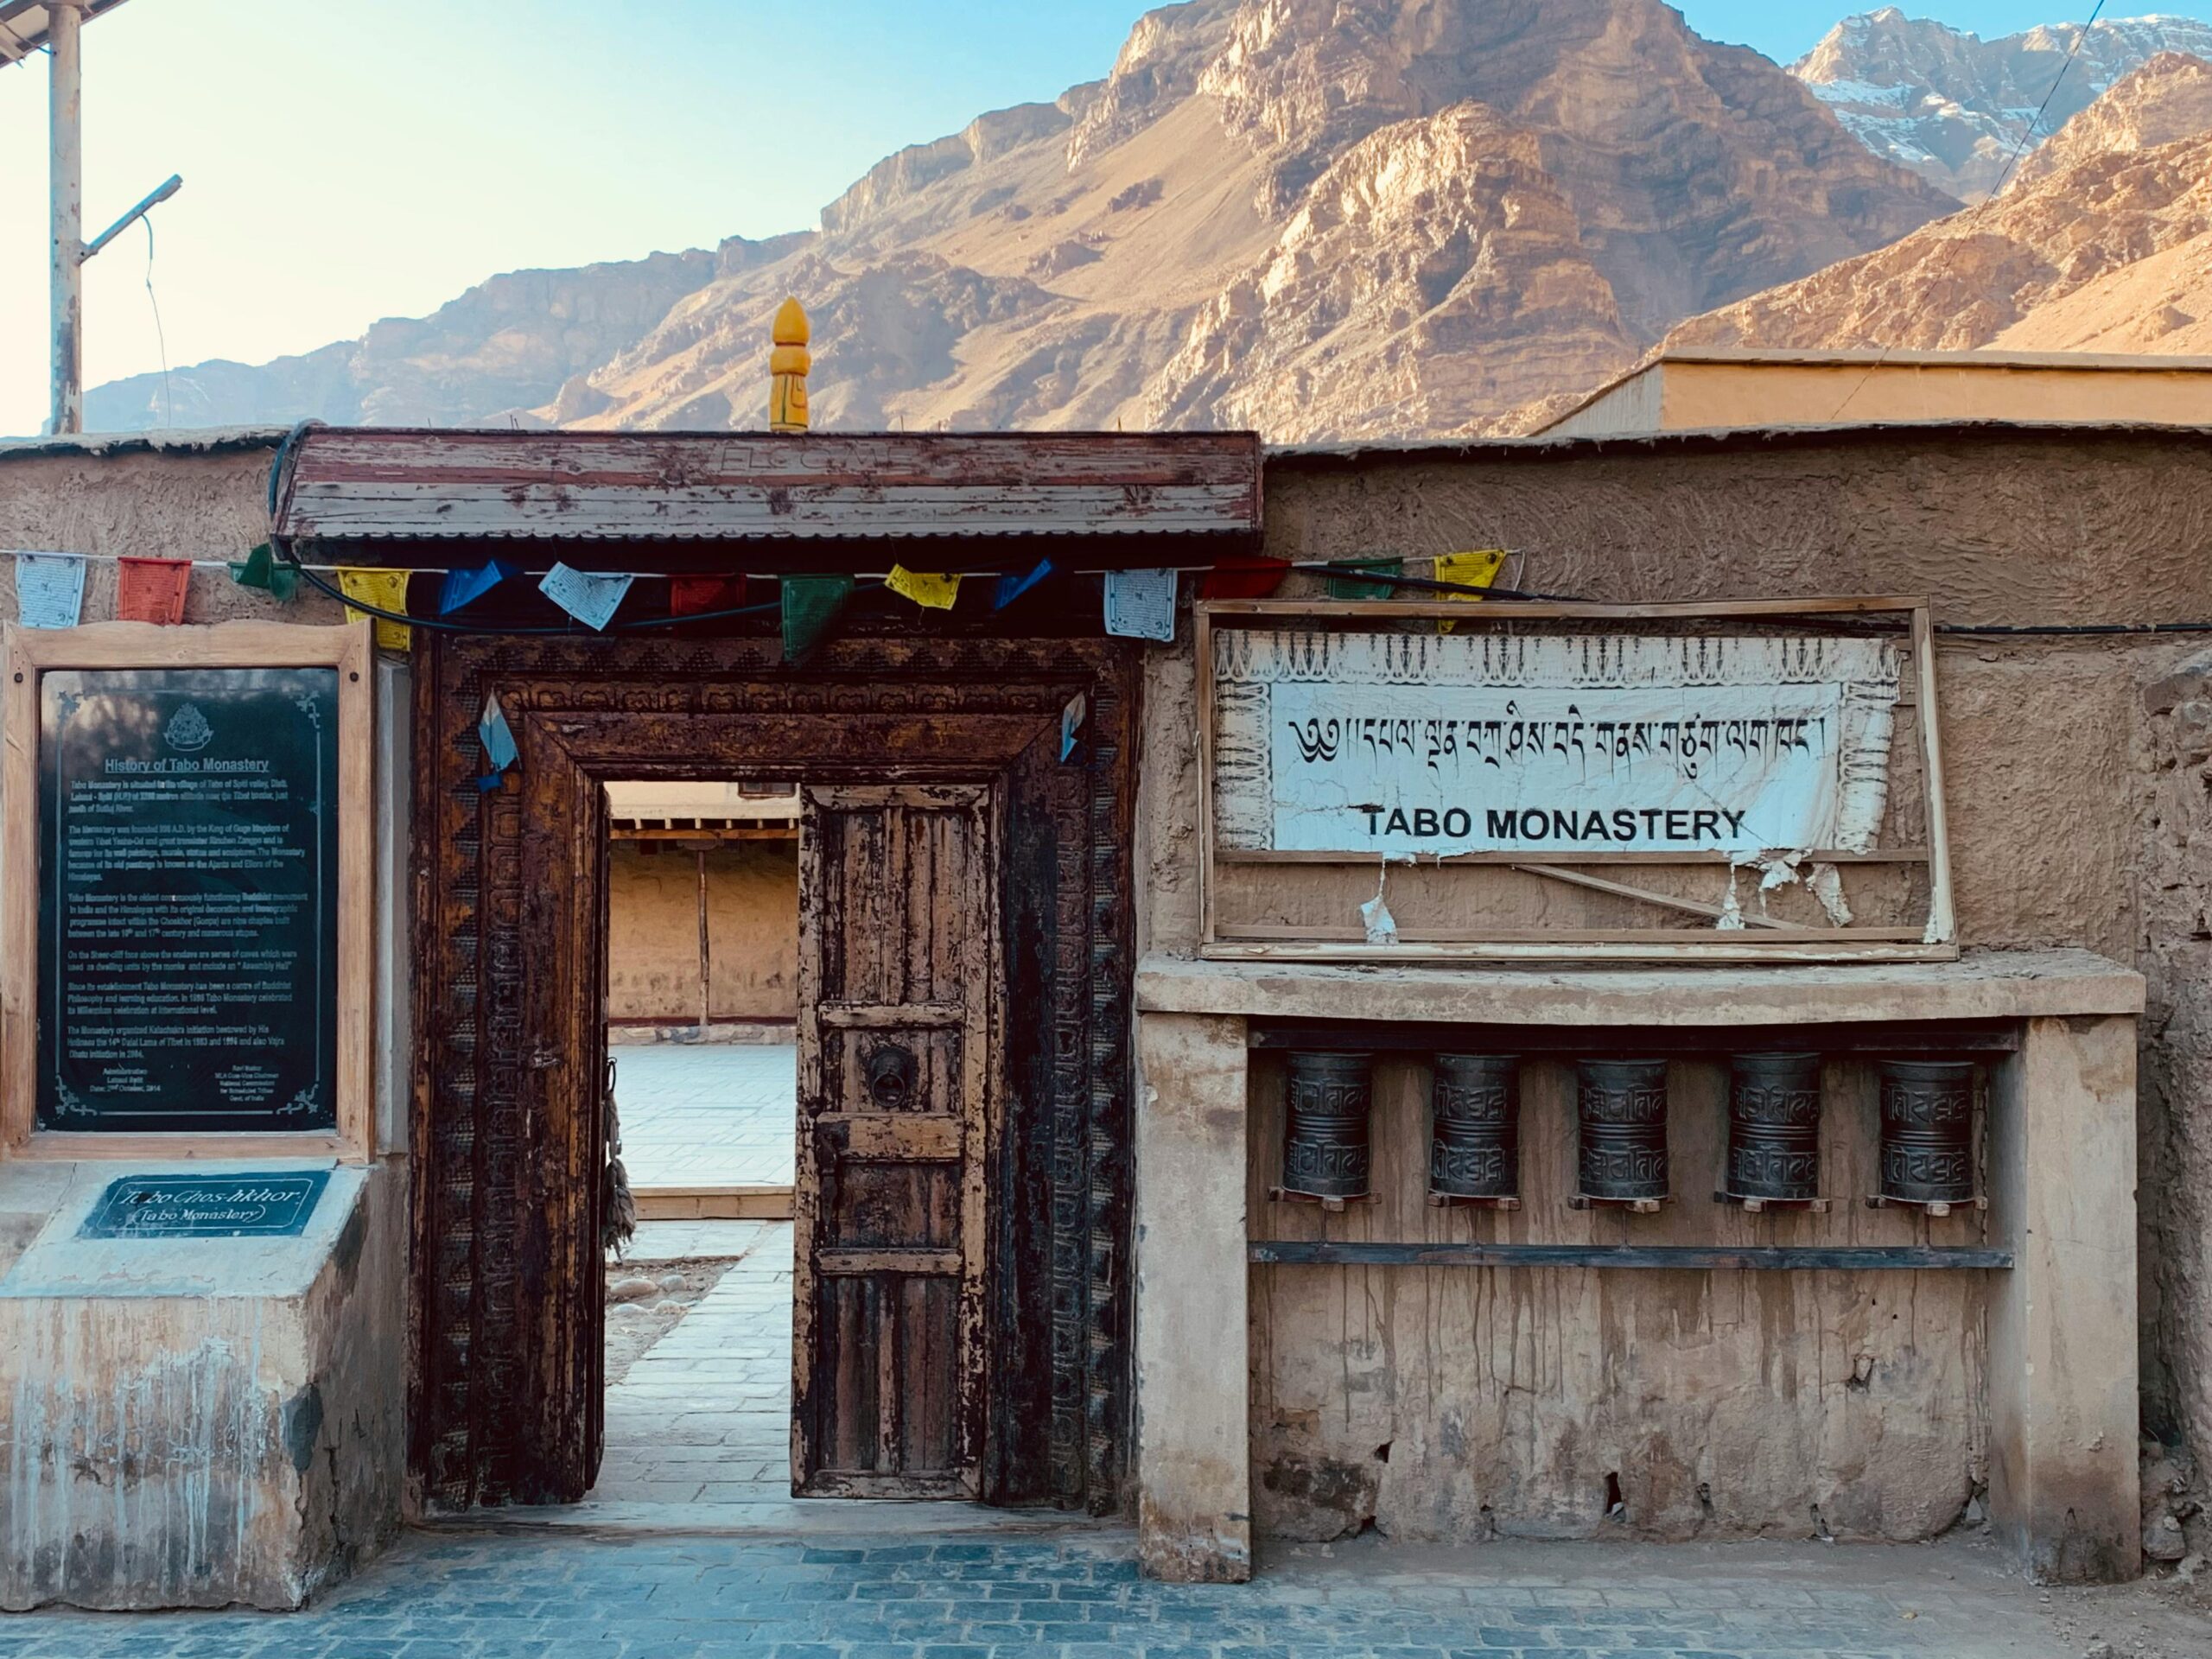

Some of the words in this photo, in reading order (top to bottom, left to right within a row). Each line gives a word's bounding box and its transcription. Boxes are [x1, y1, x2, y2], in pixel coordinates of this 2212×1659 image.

[105, 759, 150, 773] History
[154, 759, 166, 771] of
[170, 759, 200, 771] Tabo
[203, 758, 269, 772] Monastery
[1362, 808, 1471, 837] TABO
[1487, 809, 1745, 841] MONASTERY
